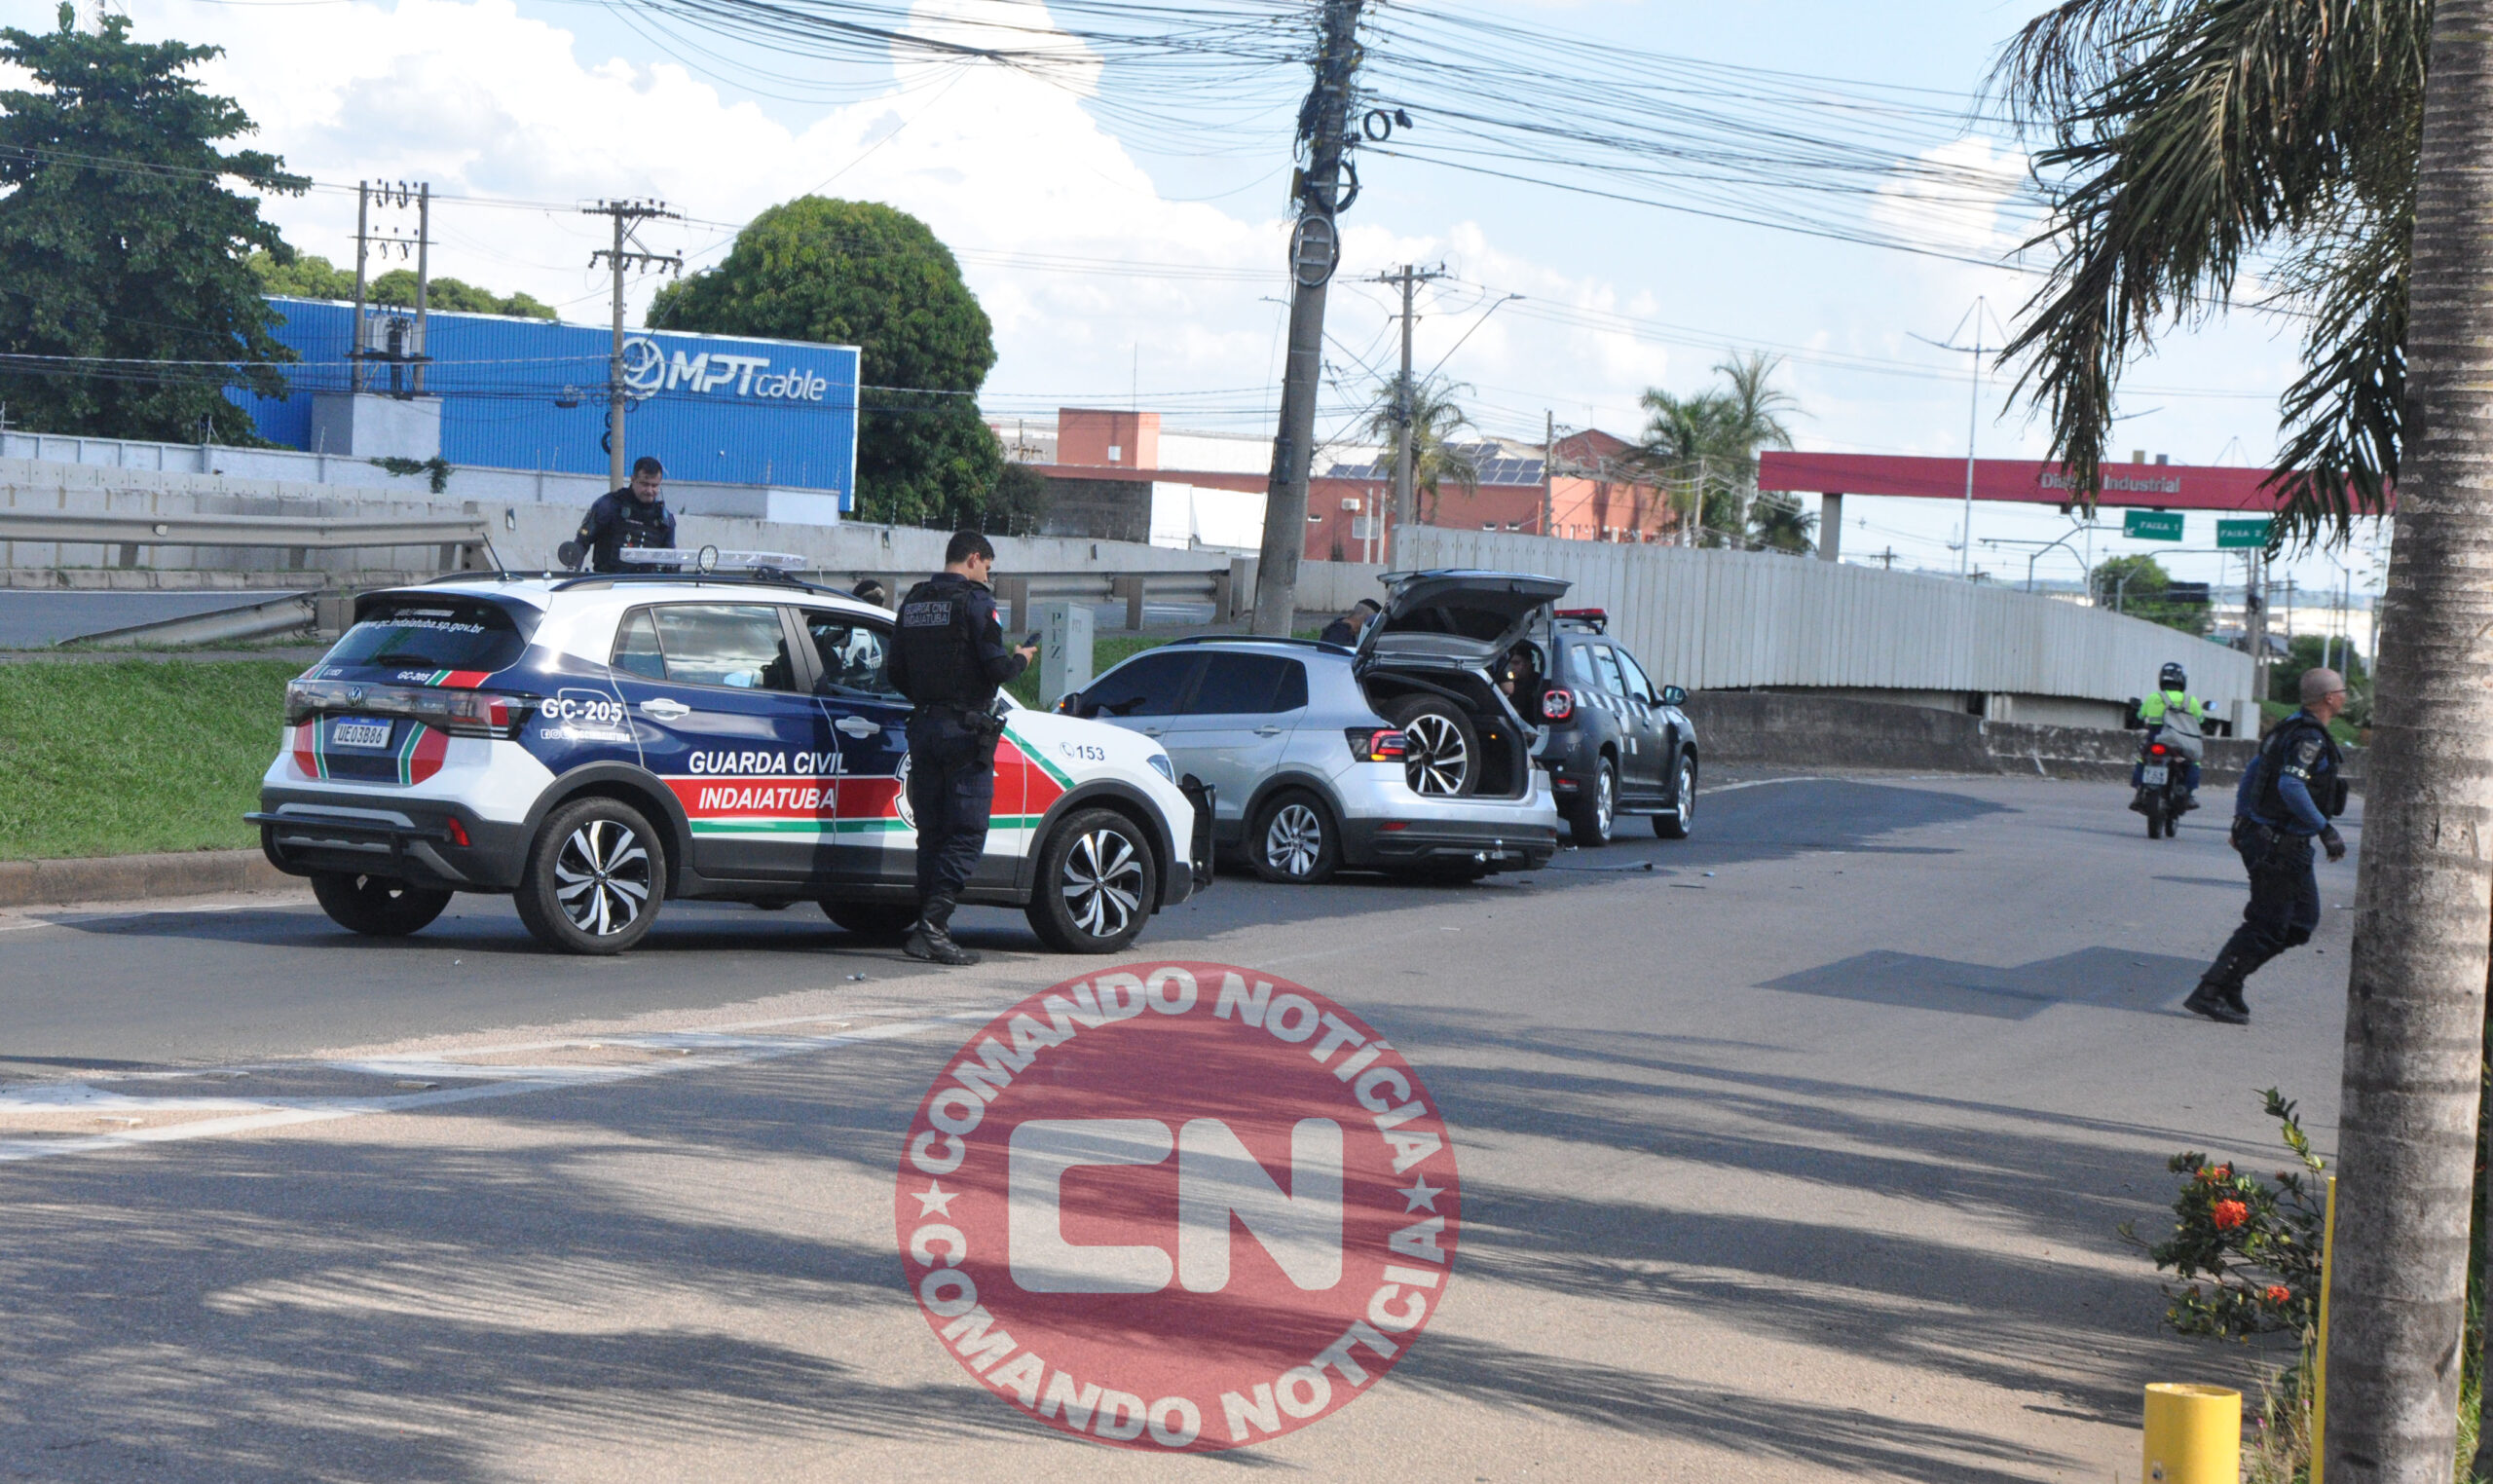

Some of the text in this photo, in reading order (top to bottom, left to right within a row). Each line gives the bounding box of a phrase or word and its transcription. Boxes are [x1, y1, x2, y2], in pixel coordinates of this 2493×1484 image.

[666, 351, 827, 401] MPT cable
[2103, 474, 2180, 494] Industrial
[397, 671, 430, 682] GC-205
[540, 698, 623, 723] GC-205
[688, 751, 848, 774] GUARDA CIVIL
[1076, 745, 1104, 761] 153
[698, 788, 835, 809] INDAIATUBA
